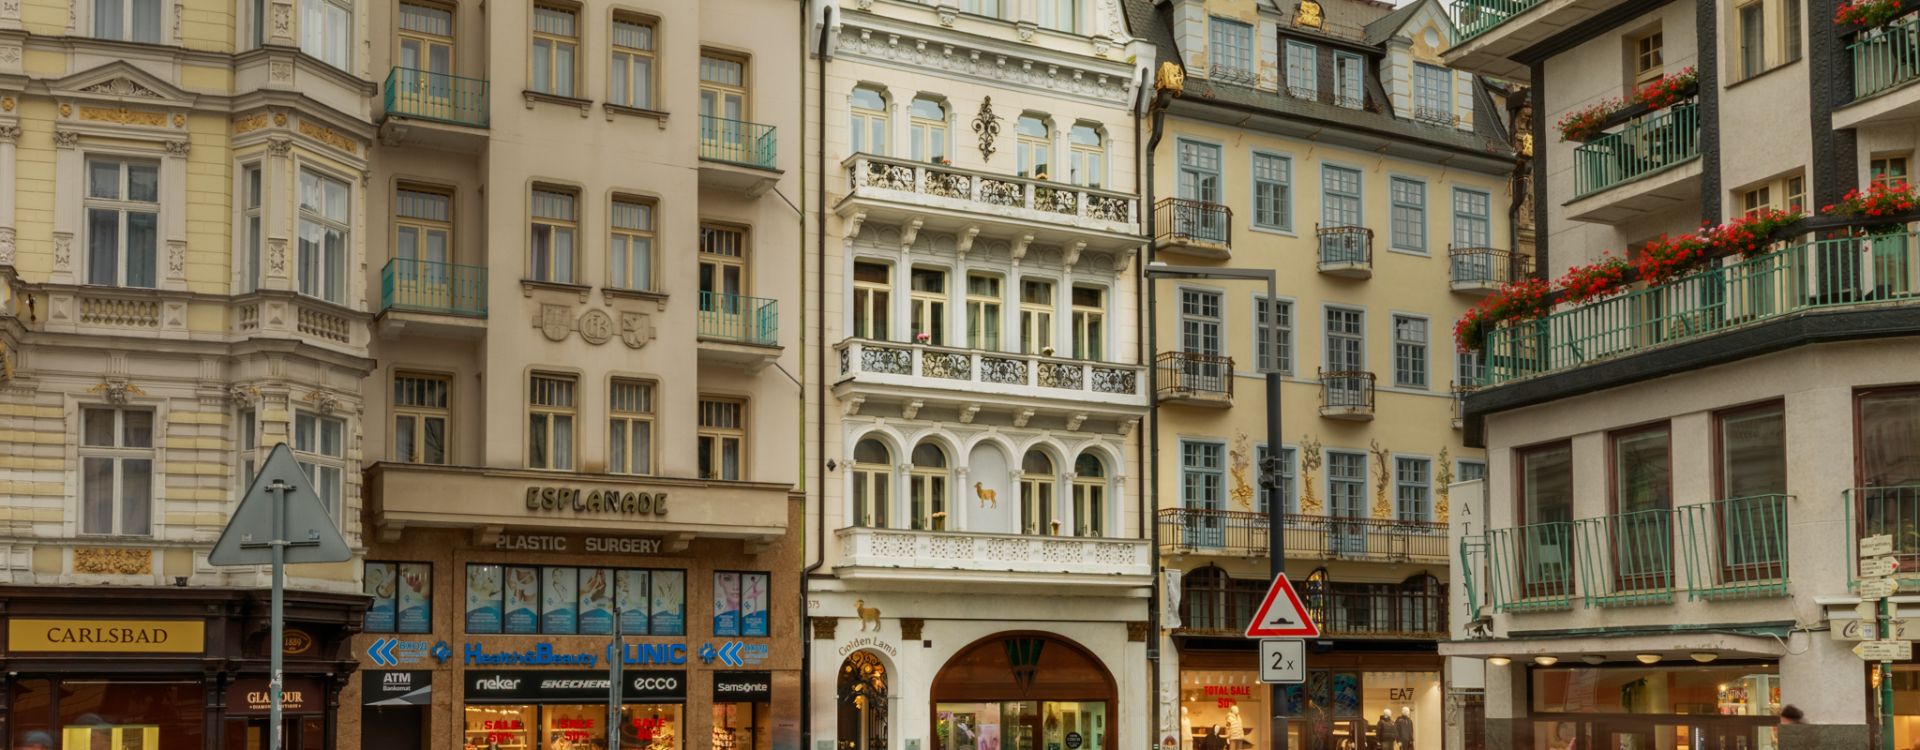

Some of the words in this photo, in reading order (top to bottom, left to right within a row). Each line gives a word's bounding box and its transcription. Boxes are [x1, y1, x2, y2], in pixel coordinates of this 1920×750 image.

[526, 486, 668, 516] ESPLANADE
[495, 535, 566, 551] PLASTIC
[585, 537, 662, 553] SURGERY
[47, 627, 168, 644] CARLSBAD
[838, 637, 871, 656] Golden
[873, 636, 897, 656] Lamb
[606, 643, 686, 665] LINIC
[1272, 652, 1284, 670] 2
[383, 672, 411, 683] ATM
[476, 675, 521, 690] rieker
[634, 677, 678, 690] ecco
[717, 683, 768, 692] Samsonite
[1204, 686, 1229, 696] TOTAL
[1230, 686, 1250, 696] SALE
[1390, 687, 1415, 701] EA7
[247, 691, 303, 703] GLAOUR
[484, 719, 520, 730] SALE
[560, 719, 595, 729] SALE
[633, 718, 666, 728] SALE
